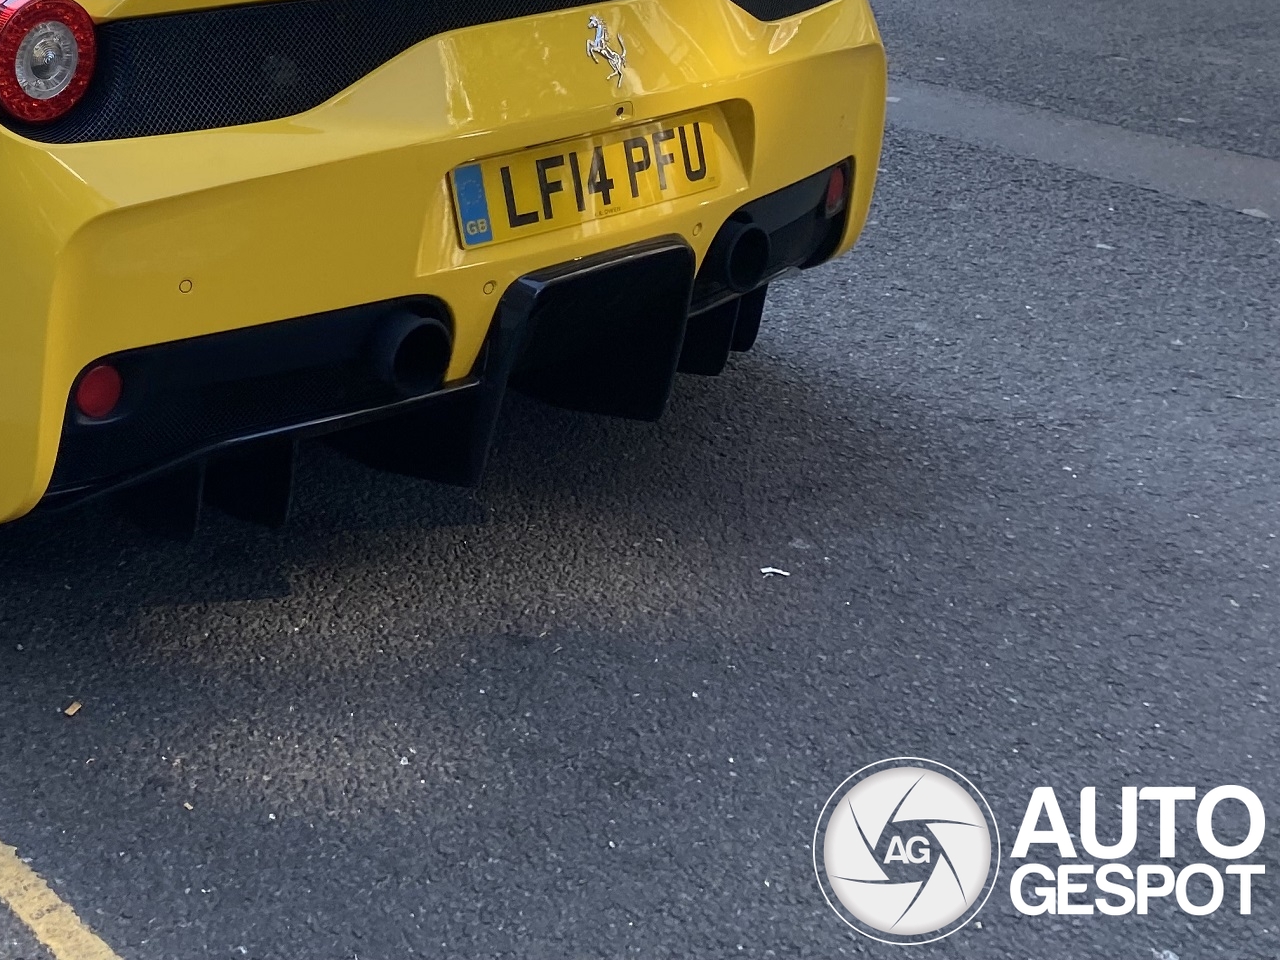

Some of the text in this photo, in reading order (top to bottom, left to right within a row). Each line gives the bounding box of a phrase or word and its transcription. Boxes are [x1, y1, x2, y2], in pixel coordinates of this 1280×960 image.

[500, 122, 707, 228] LF14 PFU
[466, 218, 488, 236] GB
